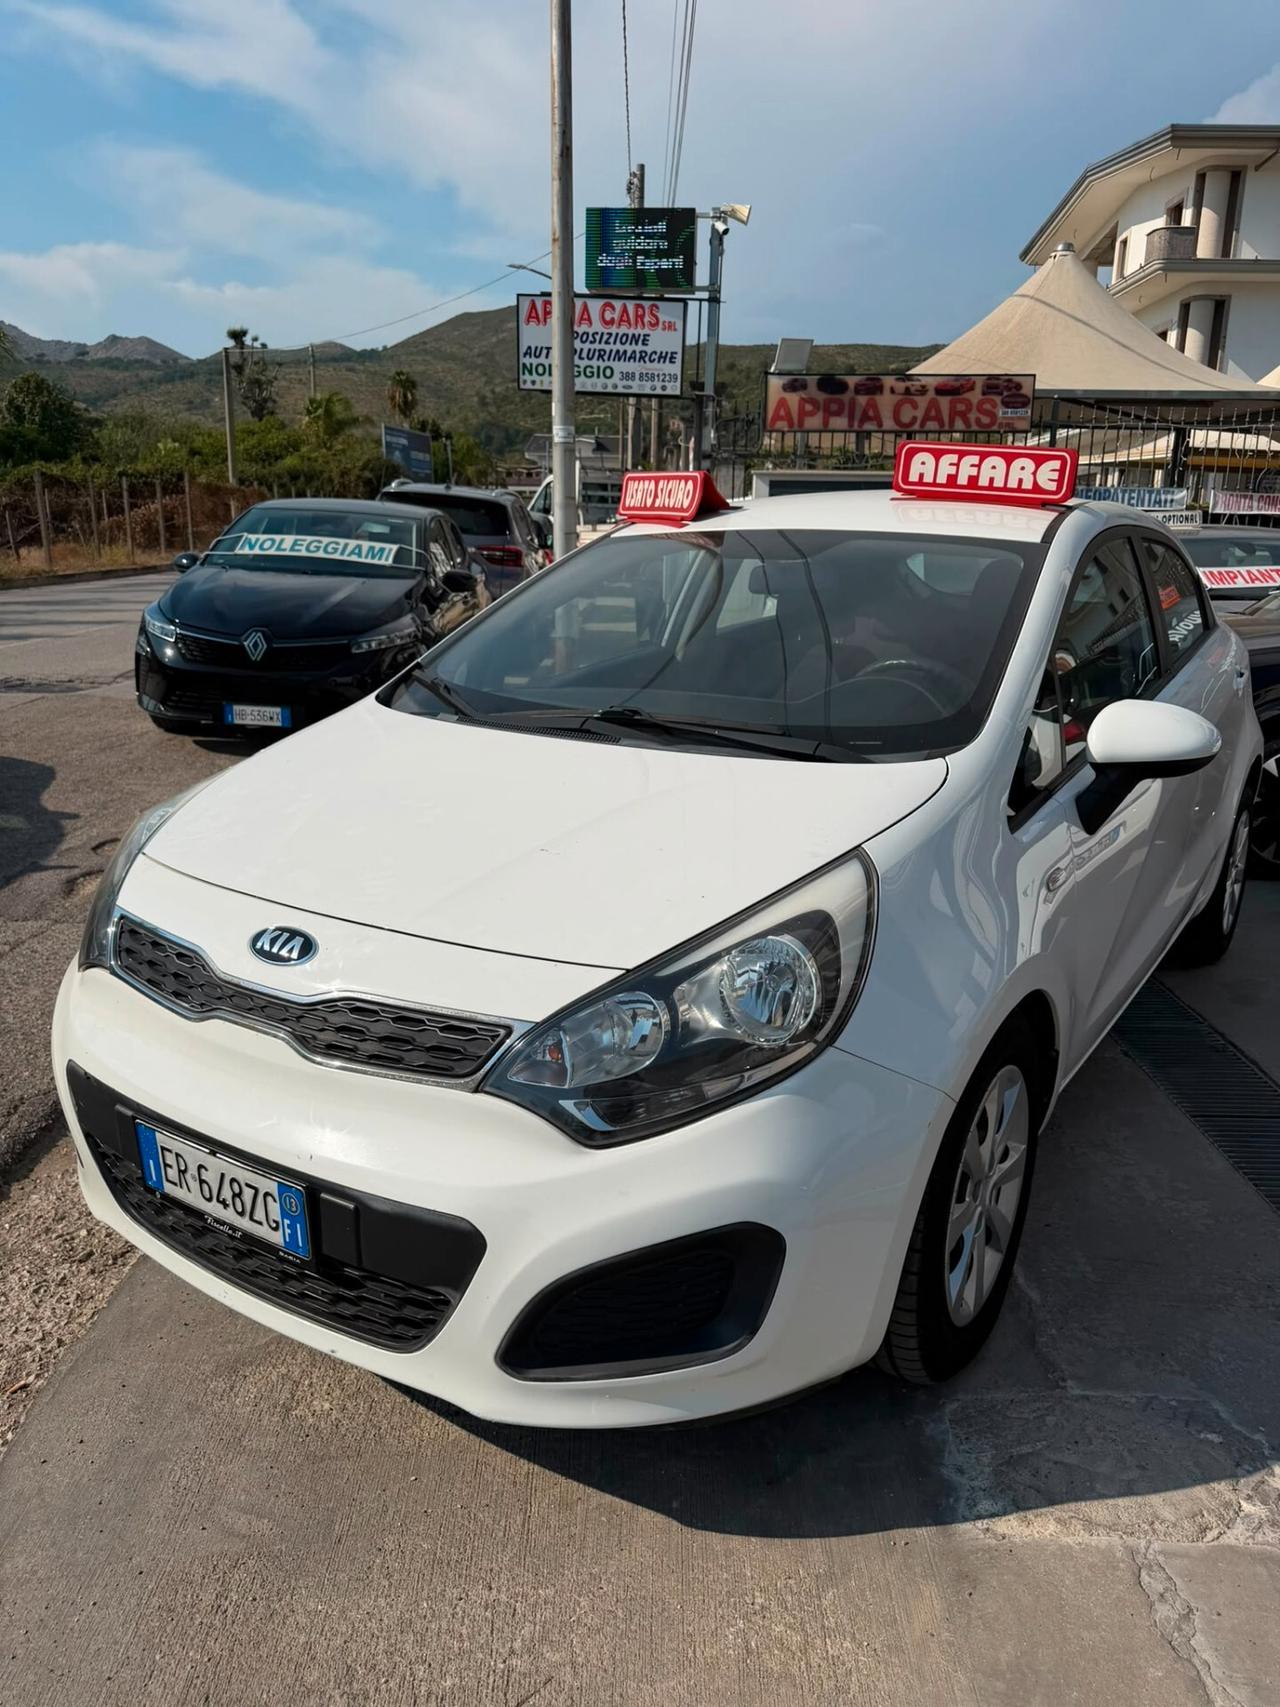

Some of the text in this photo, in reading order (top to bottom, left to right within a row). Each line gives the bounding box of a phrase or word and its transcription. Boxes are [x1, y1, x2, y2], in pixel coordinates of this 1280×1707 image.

[599, 301, 660, 331] CARS
[661, 321, 677, 332] SRL
[574, 347, 678, 364] LURIMARCHE
[619, 371, 636, 382] 388
[768, 397, 999, 430] APPIA CARS
[907, 451, 1062, 492] AFFARE
[625, 479, 694, 509] USATO SICURO
[1161, 513, 1199, 526] OPTIONAL
[241, 537, 392, 562] NOLEGGIAMI
[255, 926, 305, 960] KIA
